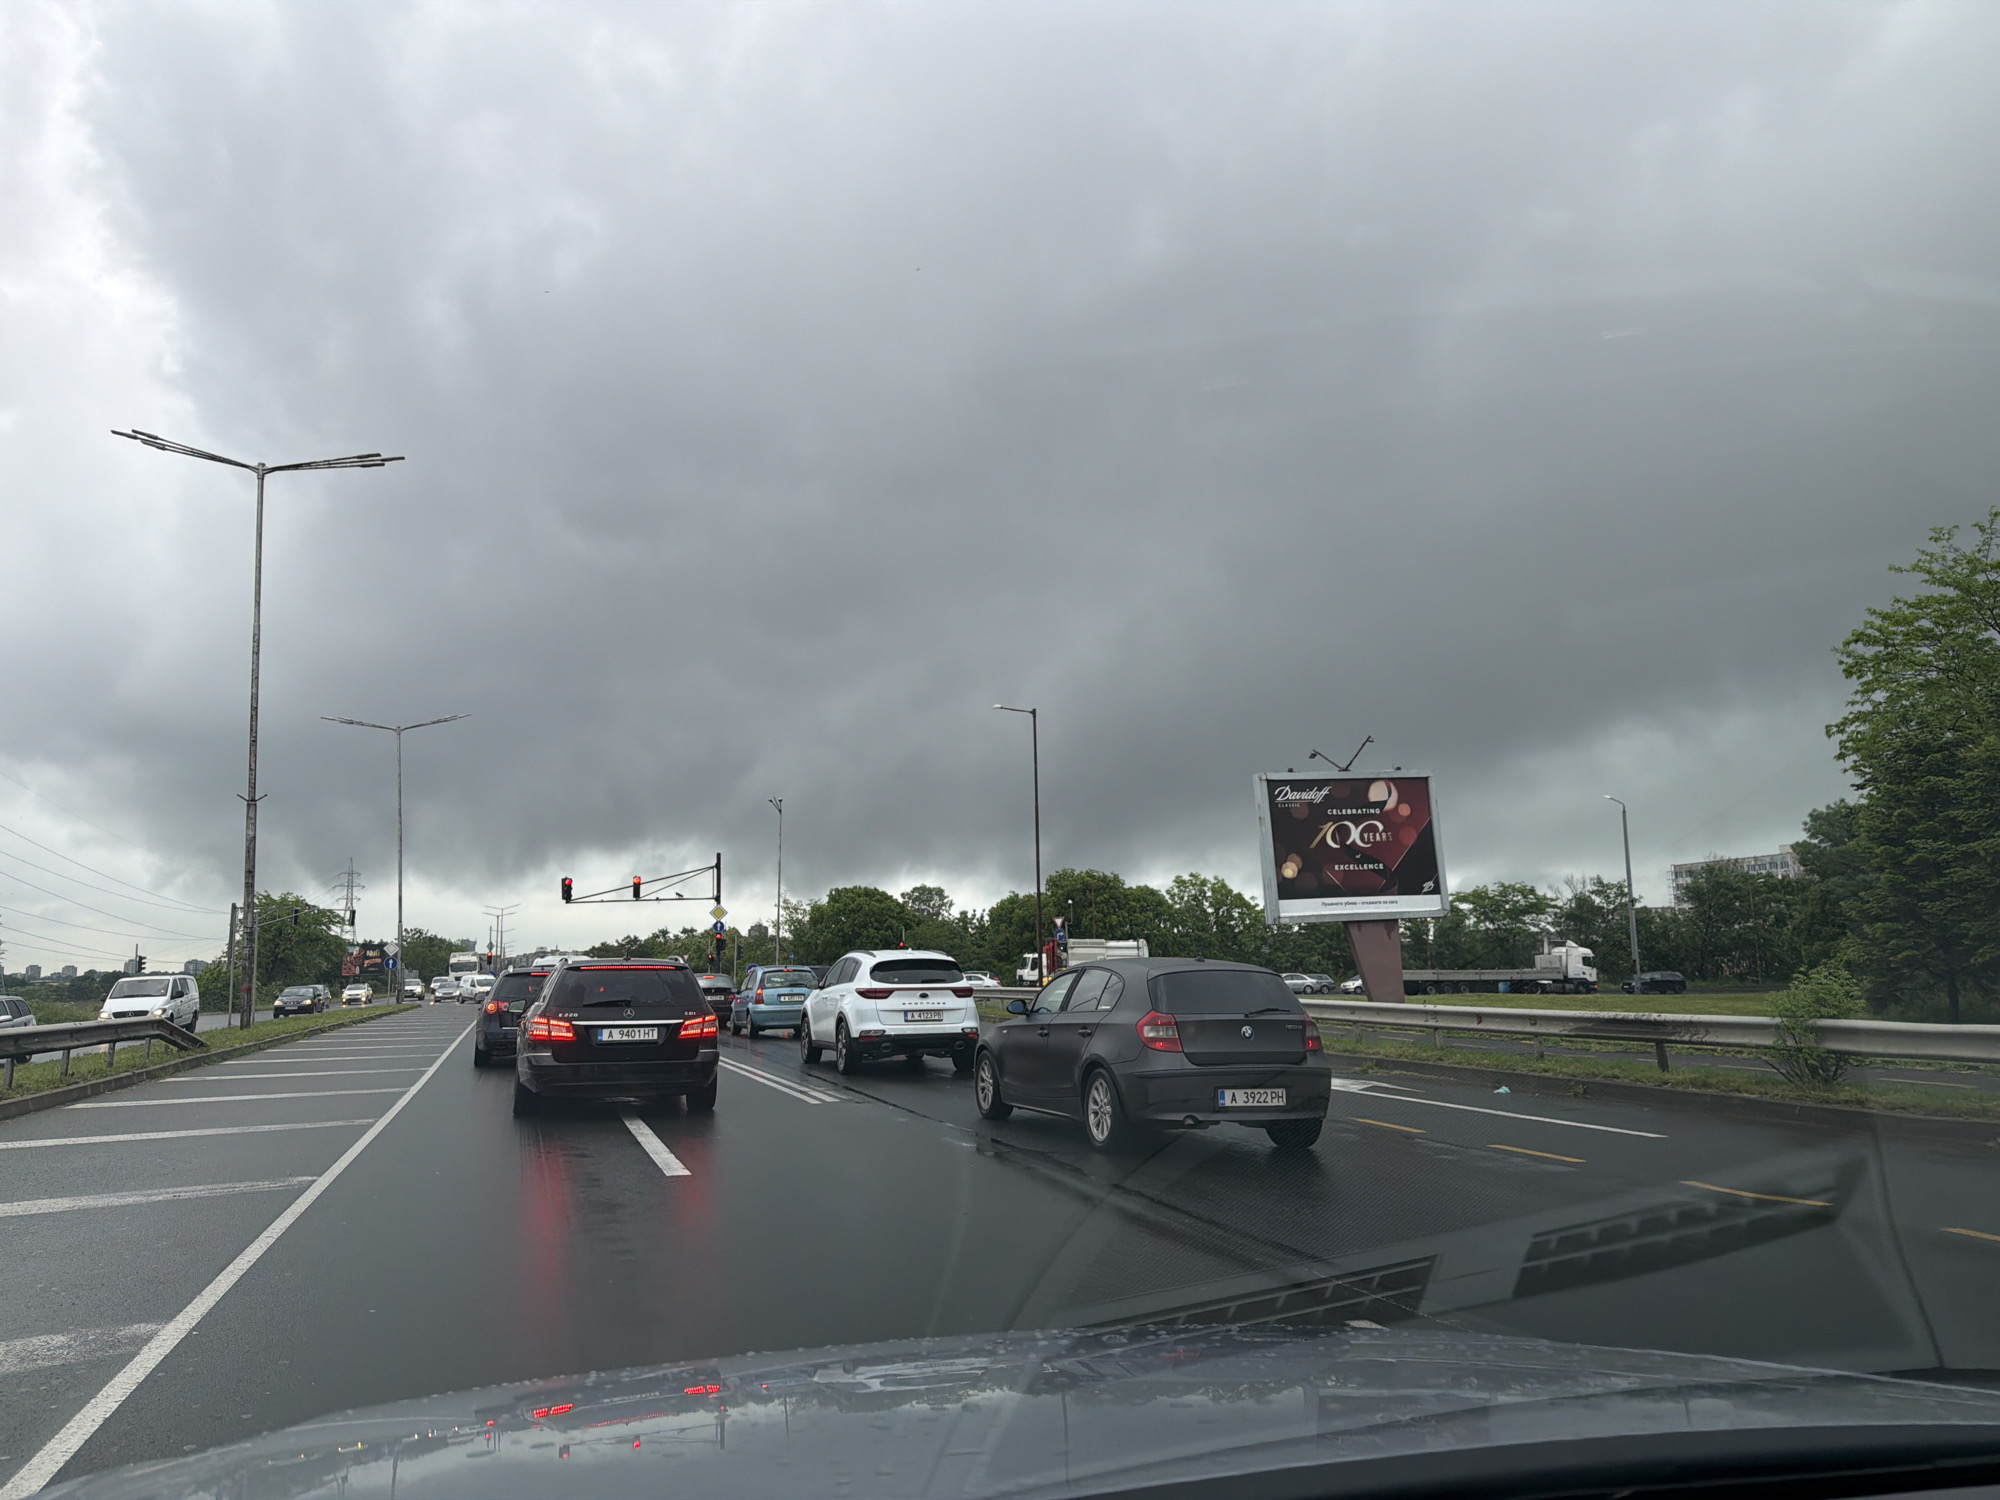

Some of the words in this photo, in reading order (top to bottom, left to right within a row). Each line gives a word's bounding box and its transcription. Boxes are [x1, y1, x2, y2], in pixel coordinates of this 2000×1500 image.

[1274, 785, 1332, 804] Davidoff
[1309, 820, 1384, 849] 100
[1363, 832, 1393, 842] YEARS
[1334, 863, 1384, 871] EXCELLENCE
[607, 1031, 614, 1039] A
[1230, 1092, 1238, 1104] A
